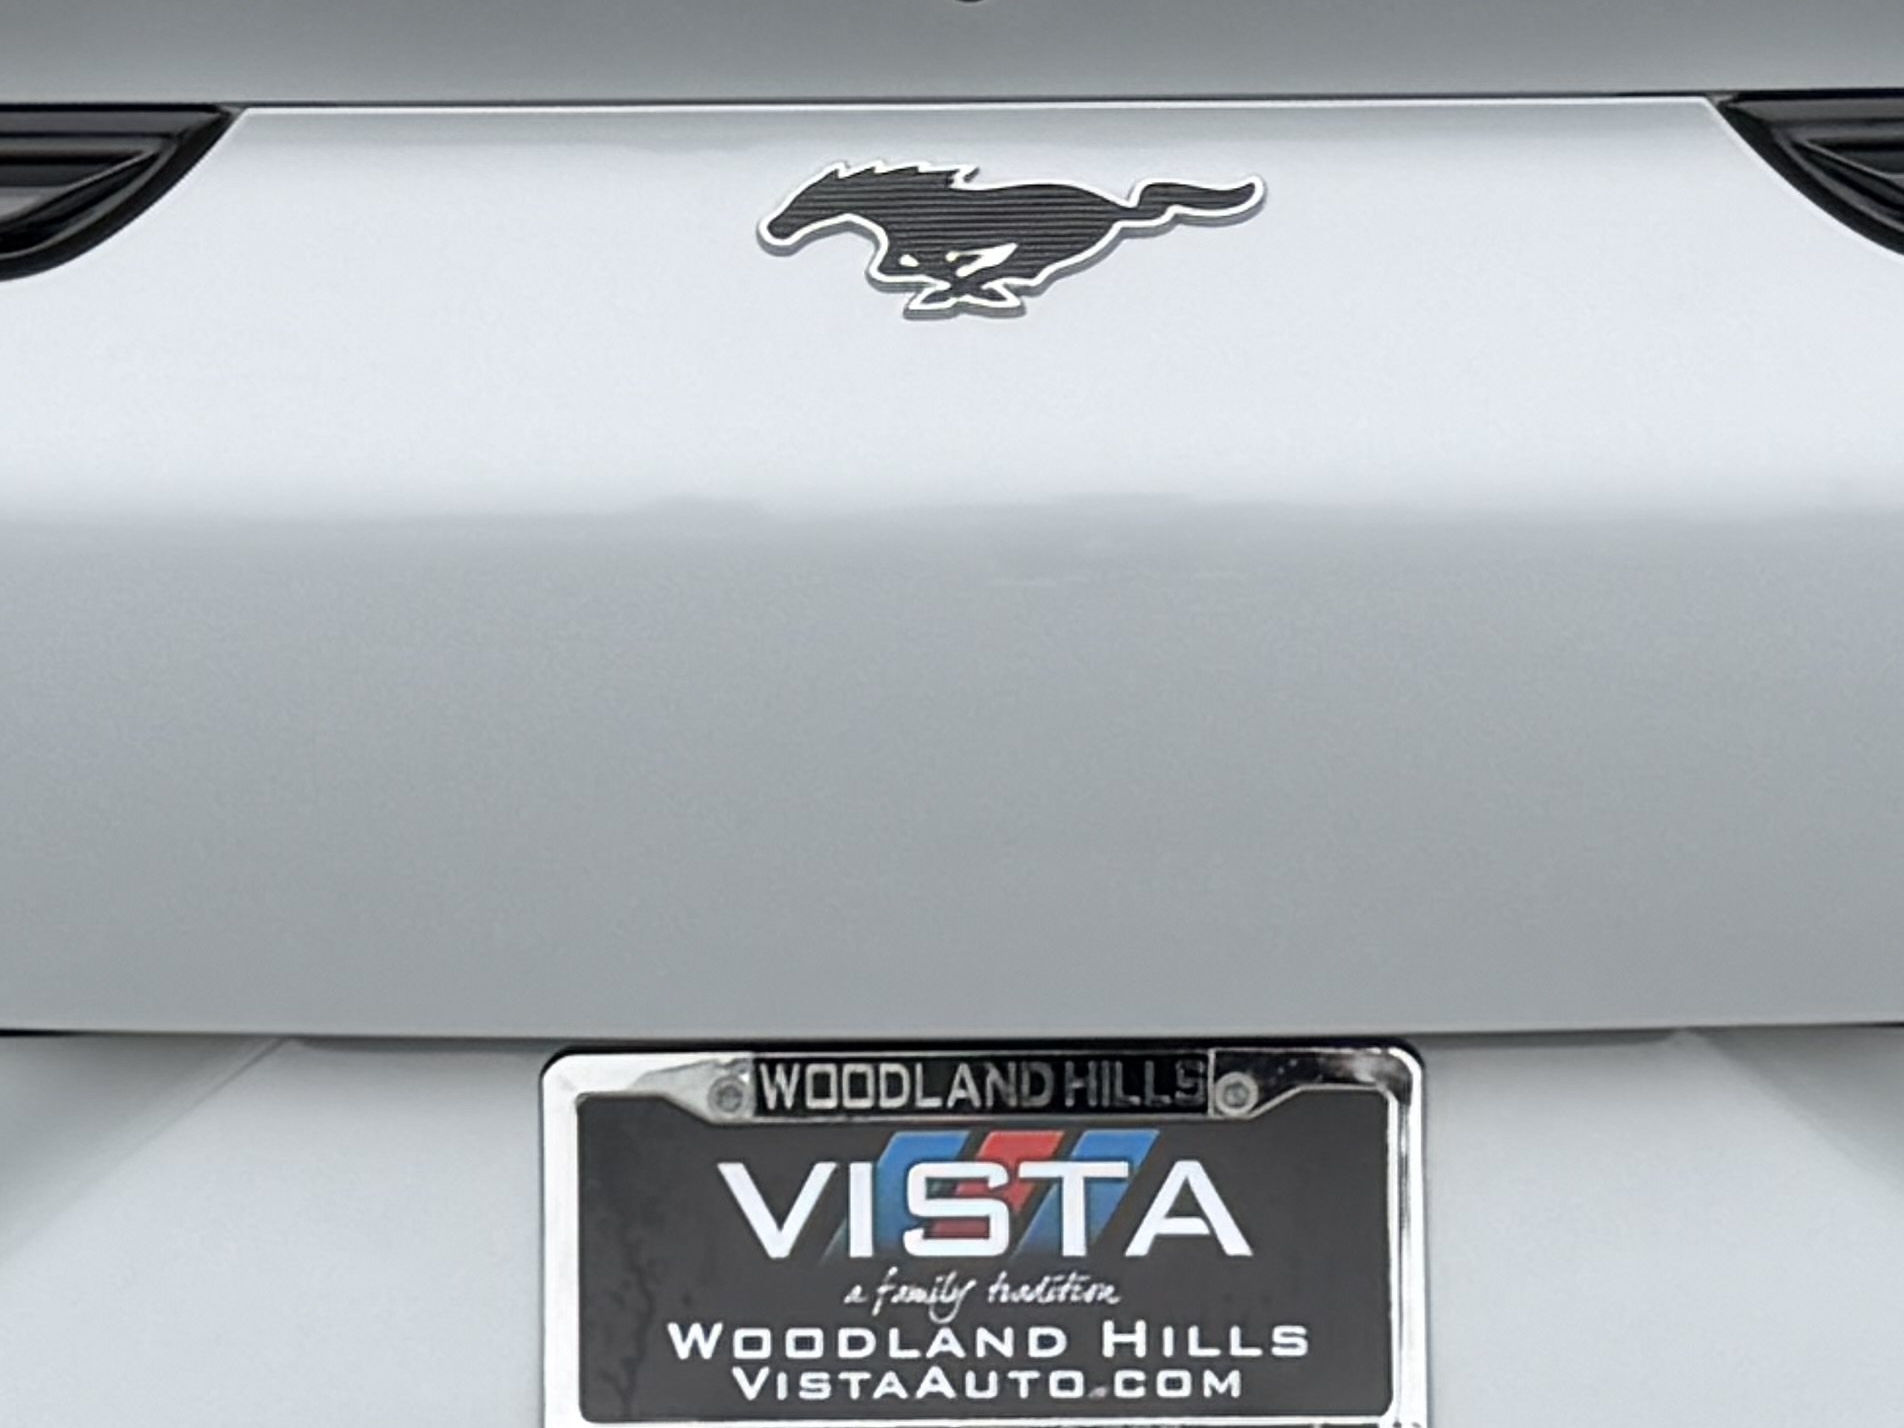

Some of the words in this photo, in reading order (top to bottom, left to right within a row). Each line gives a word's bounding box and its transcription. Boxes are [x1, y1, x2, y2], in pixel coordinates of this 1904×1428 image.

[759, 1061, 1054, 1110] WOODLAND
[1064, 1059, 1207, 1108] HILLS
[716, 1160, 1254, 1259] VISTA
[843, 1284, 867, 1304] a
[871, 1266, 977, 1325] family
[987, 1270, 1122, 1305] tradition
